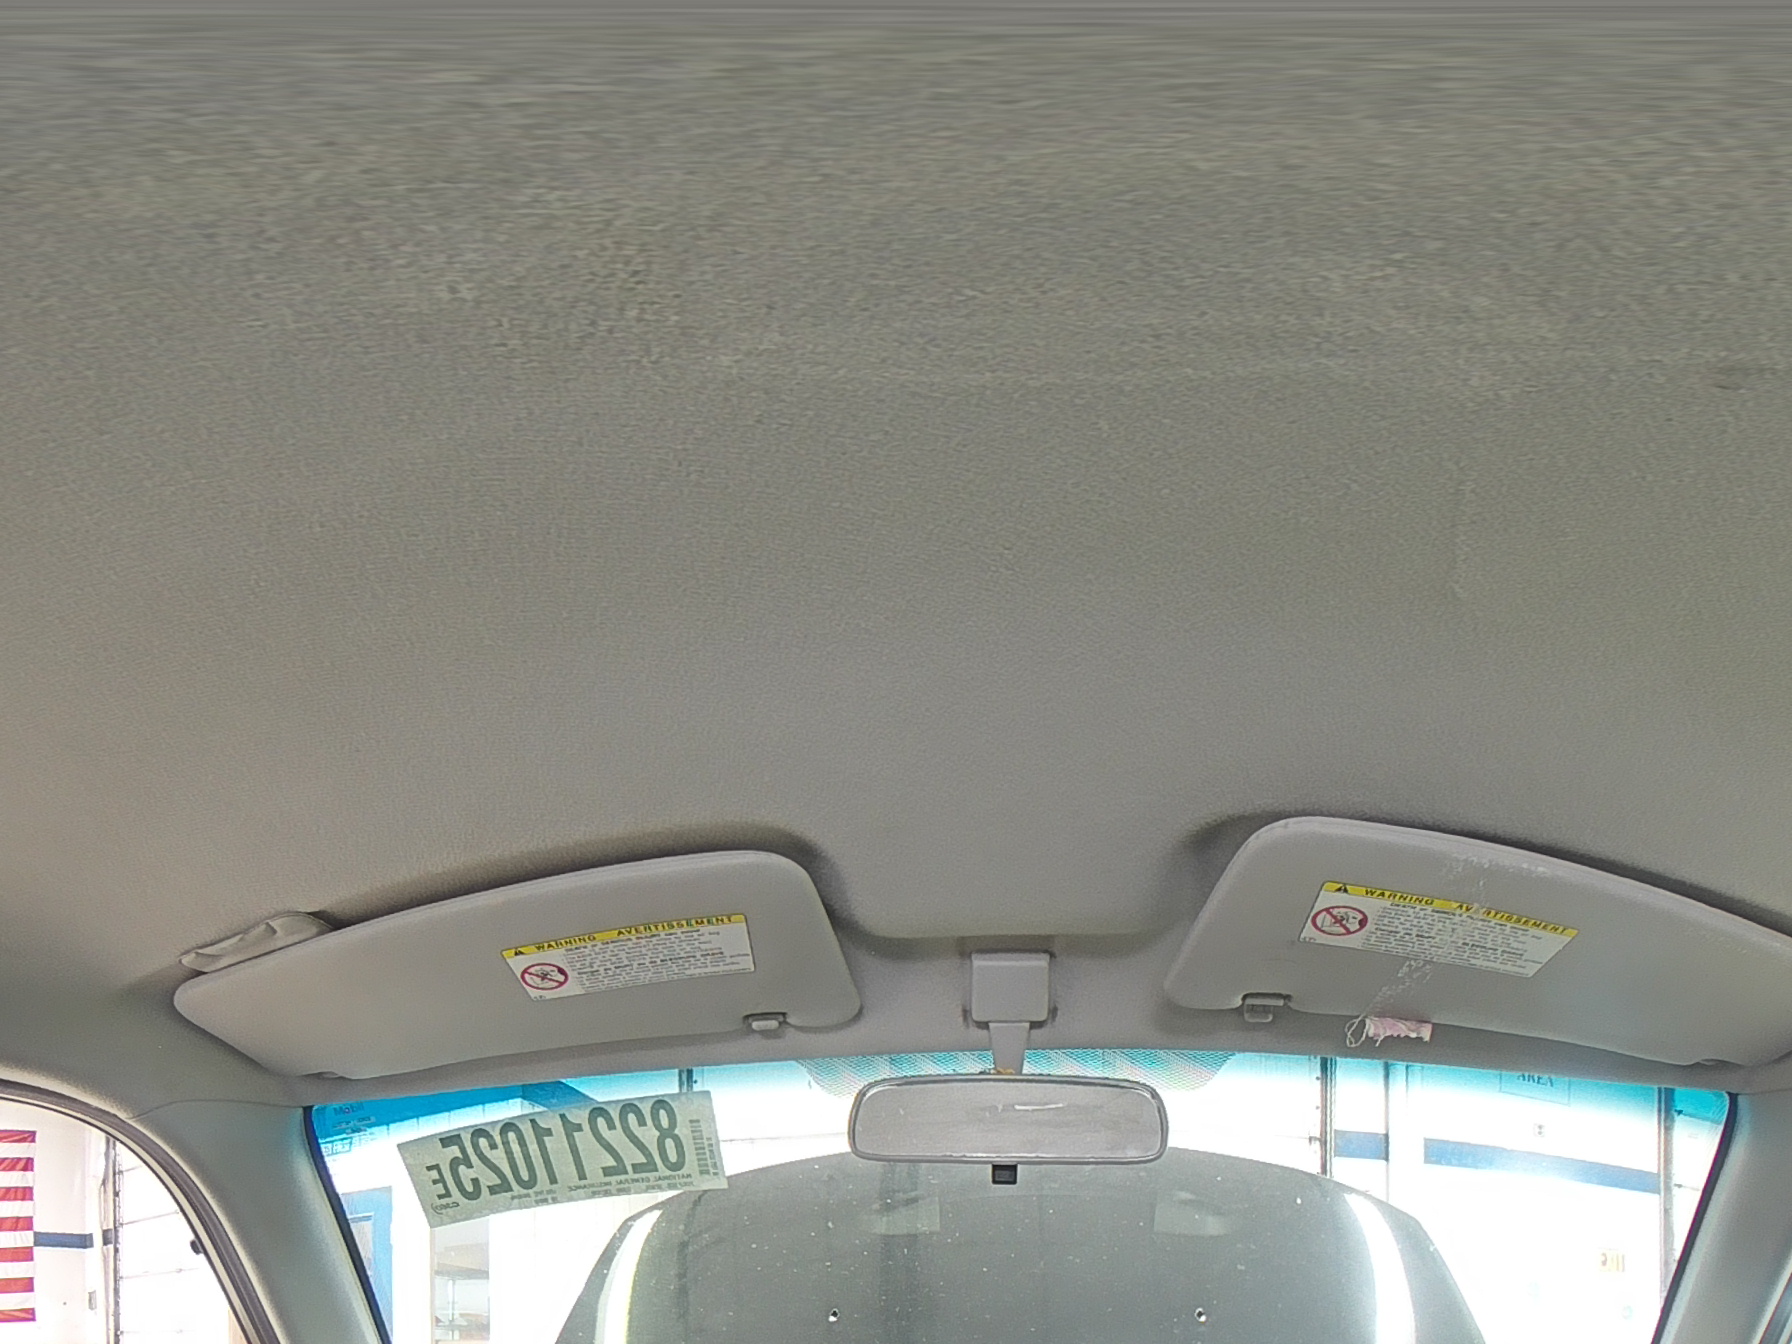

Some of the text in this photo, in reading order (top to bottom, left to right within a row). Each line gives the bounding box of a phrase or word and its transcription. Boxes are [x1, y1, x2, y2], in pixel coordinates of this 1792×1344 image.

[1364, 887, 1568, 934] WARNING AVRTISSEMENT
[535, 915, 733, 952] WARNING AVERTISSEMENT
